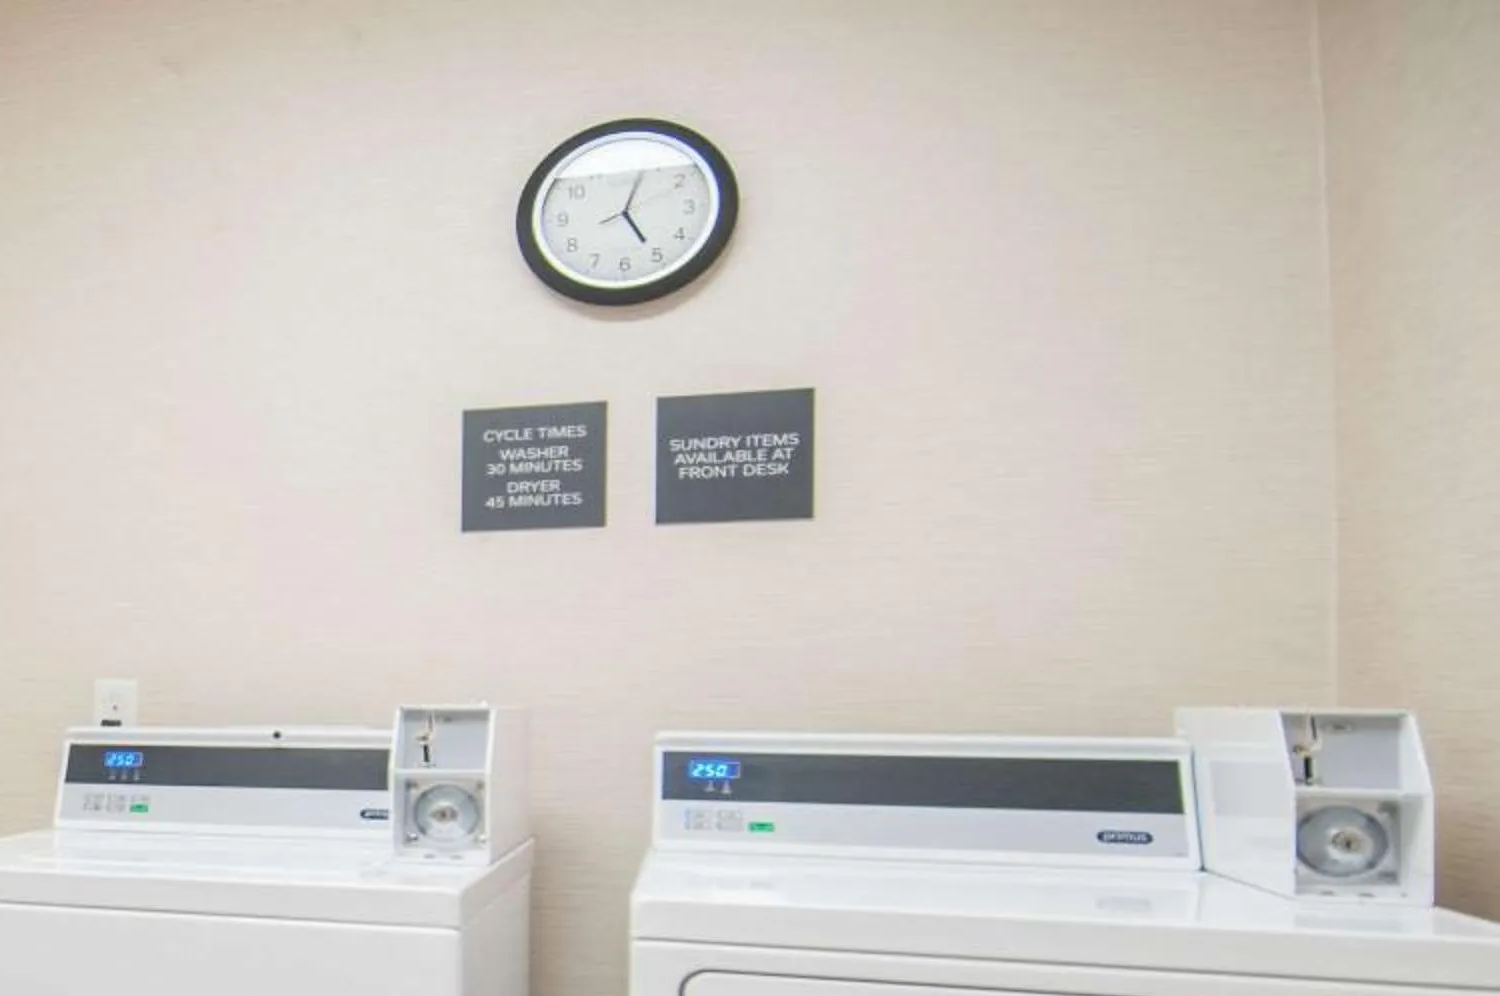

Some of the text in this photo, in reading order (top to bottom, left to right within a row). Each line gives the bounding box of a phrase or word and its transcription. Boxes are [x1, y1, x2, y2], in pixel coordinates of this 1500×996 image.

[673, 174, 686, 189] 2
[568, 185, 585, 200] 10
[683, 200, 695, 215] 3
[557, 212, 568, 227] 9
[674, 227, 686, 240] 4
[567, 238, 578, 252] 8
[590, 253, 601, 268] 7
[652, 248, 663, 262] 5
[619, 257, 631, 271] 6
[483, 425, 587, 442] CYCLE TIMES
[669, 433, 800, 452] SUNDRY ITEMS
[500, 446, 569, 461] WASHER
[674, 448, 795, 465] AVAILABLE AT
[486, 459, 583, 475] 30 MINUTES
[678, 463, 789, 479] FRONT DESK
[507, 480, 560, 493] DRYER
[484, 492, 583, 509] 45 MINUTES
[106, 752, 135, 767] 250
[691, 763, 728, 777] 250
